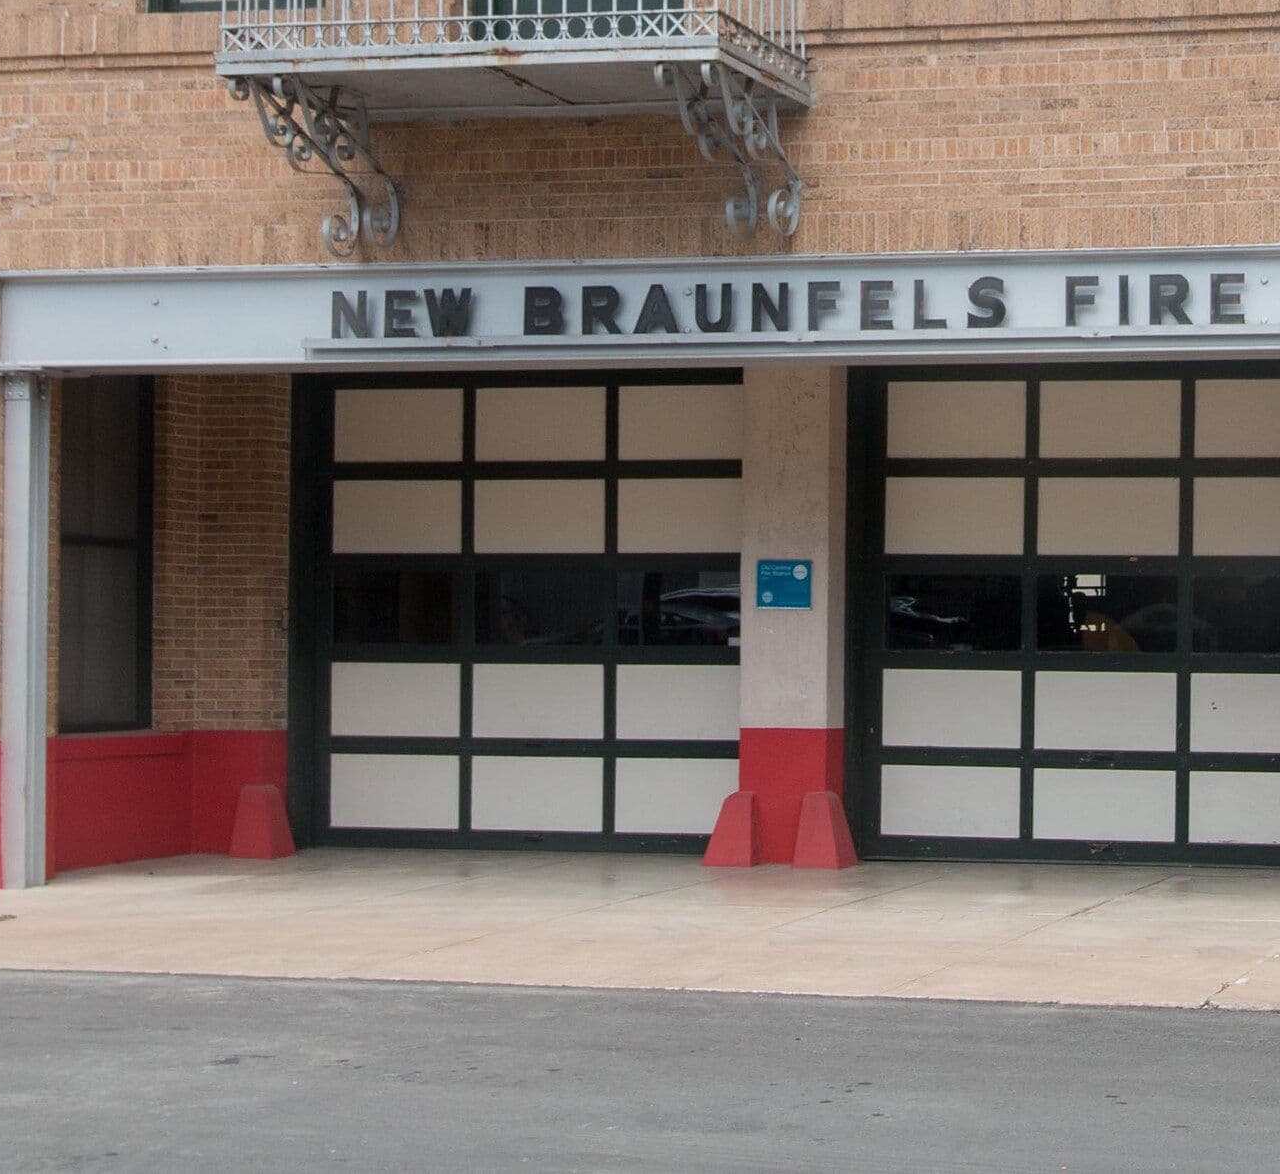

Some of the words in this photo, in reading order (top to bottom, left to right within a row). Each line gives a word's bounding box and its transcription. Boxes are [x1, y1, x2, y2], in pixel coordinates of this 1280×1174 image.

[331, 287, 473, 338] NEW
[523, 276, 1006, 335] BRAUNFELS
[1065, 272, 1246, 326] FIRE
